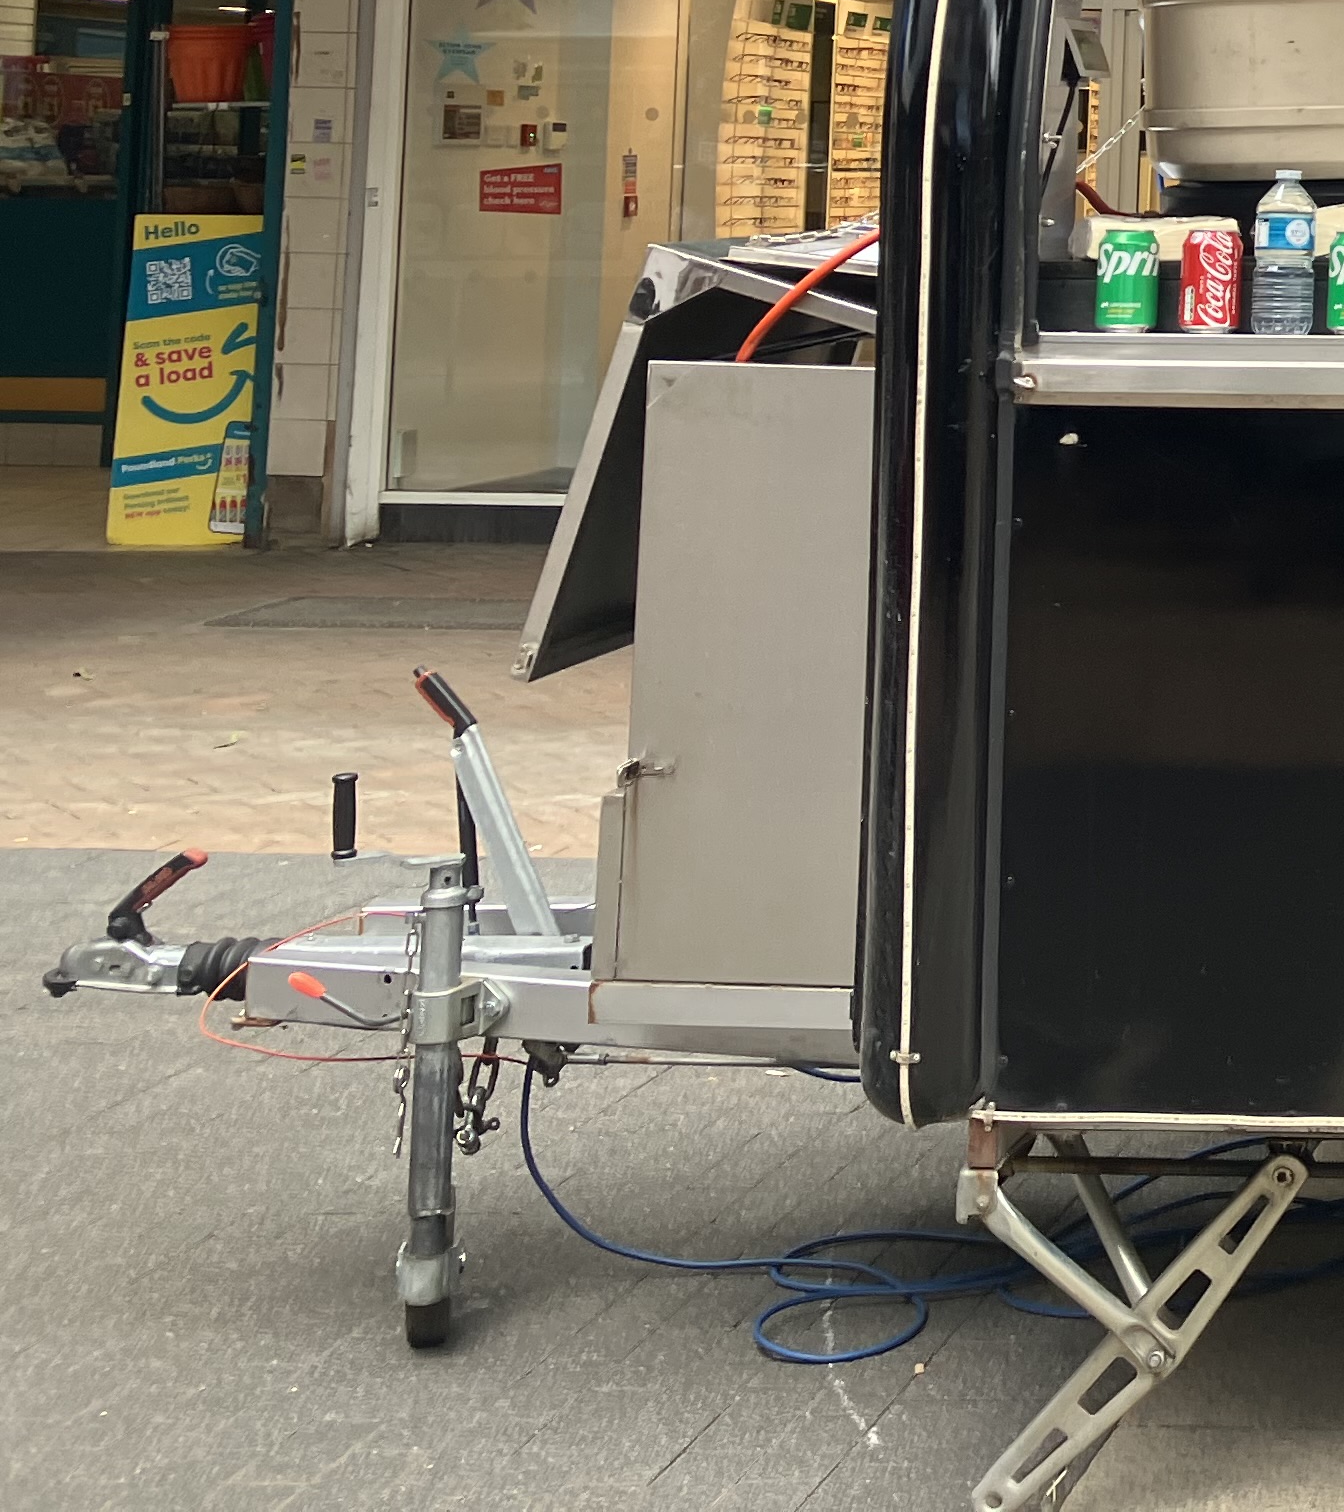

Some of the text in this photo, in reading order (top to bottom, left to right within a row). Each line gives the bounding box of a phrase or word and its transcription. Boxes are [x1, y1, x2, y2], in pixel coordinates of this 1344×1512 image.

[143, 221, 200, 240] Hello
[134, 345, 212, 368] & save
[135, 361, 213, 388] a load
